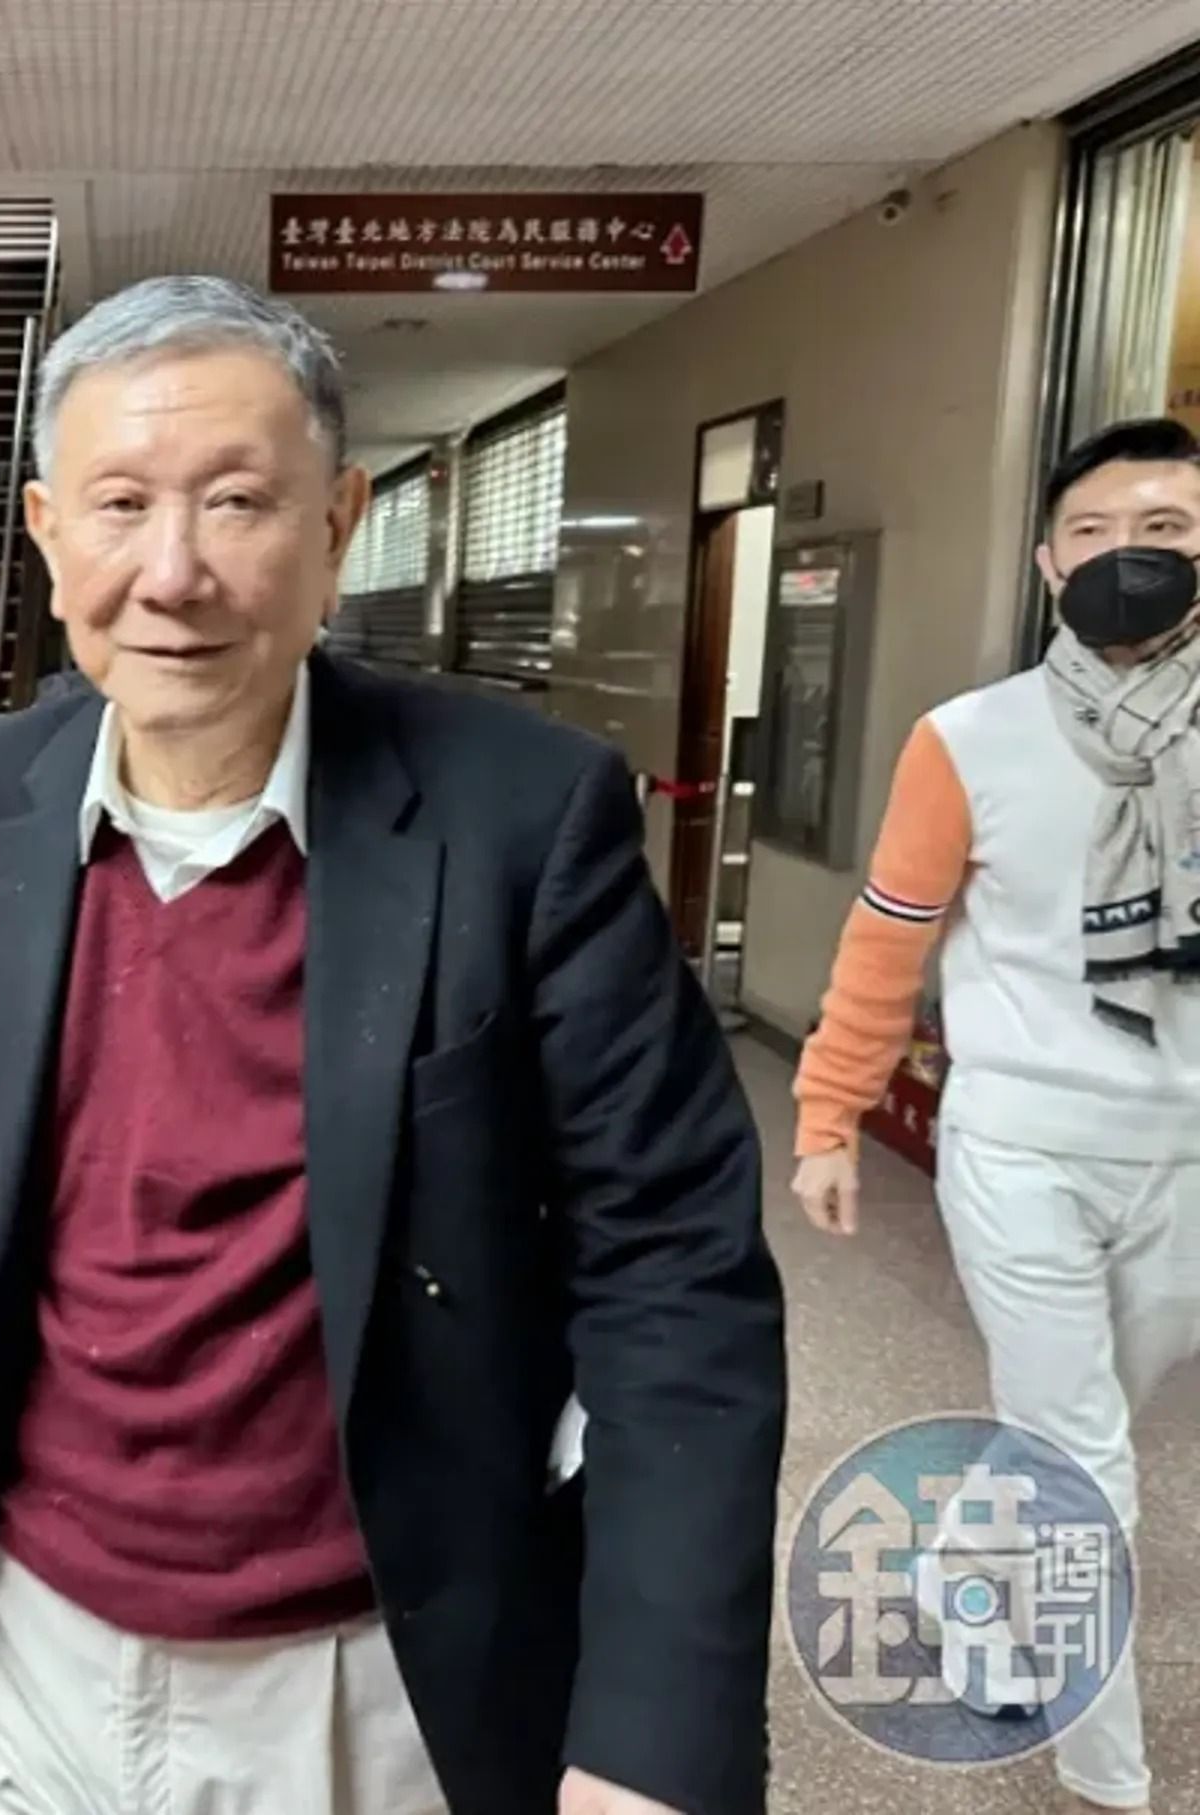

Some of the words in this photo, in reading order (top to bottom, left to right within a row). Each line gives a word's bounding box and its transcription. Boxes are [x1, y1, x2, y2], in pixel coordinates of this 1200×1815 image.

[282, 253, 340, 271] Taiwan
[347, 253, 395, 271] Taipei
[401, 253, 464, 270] District
[468, 252, 516, 271] Court
[521, 253, 583, 271] Service
[588, 252, 646, 271] Center
